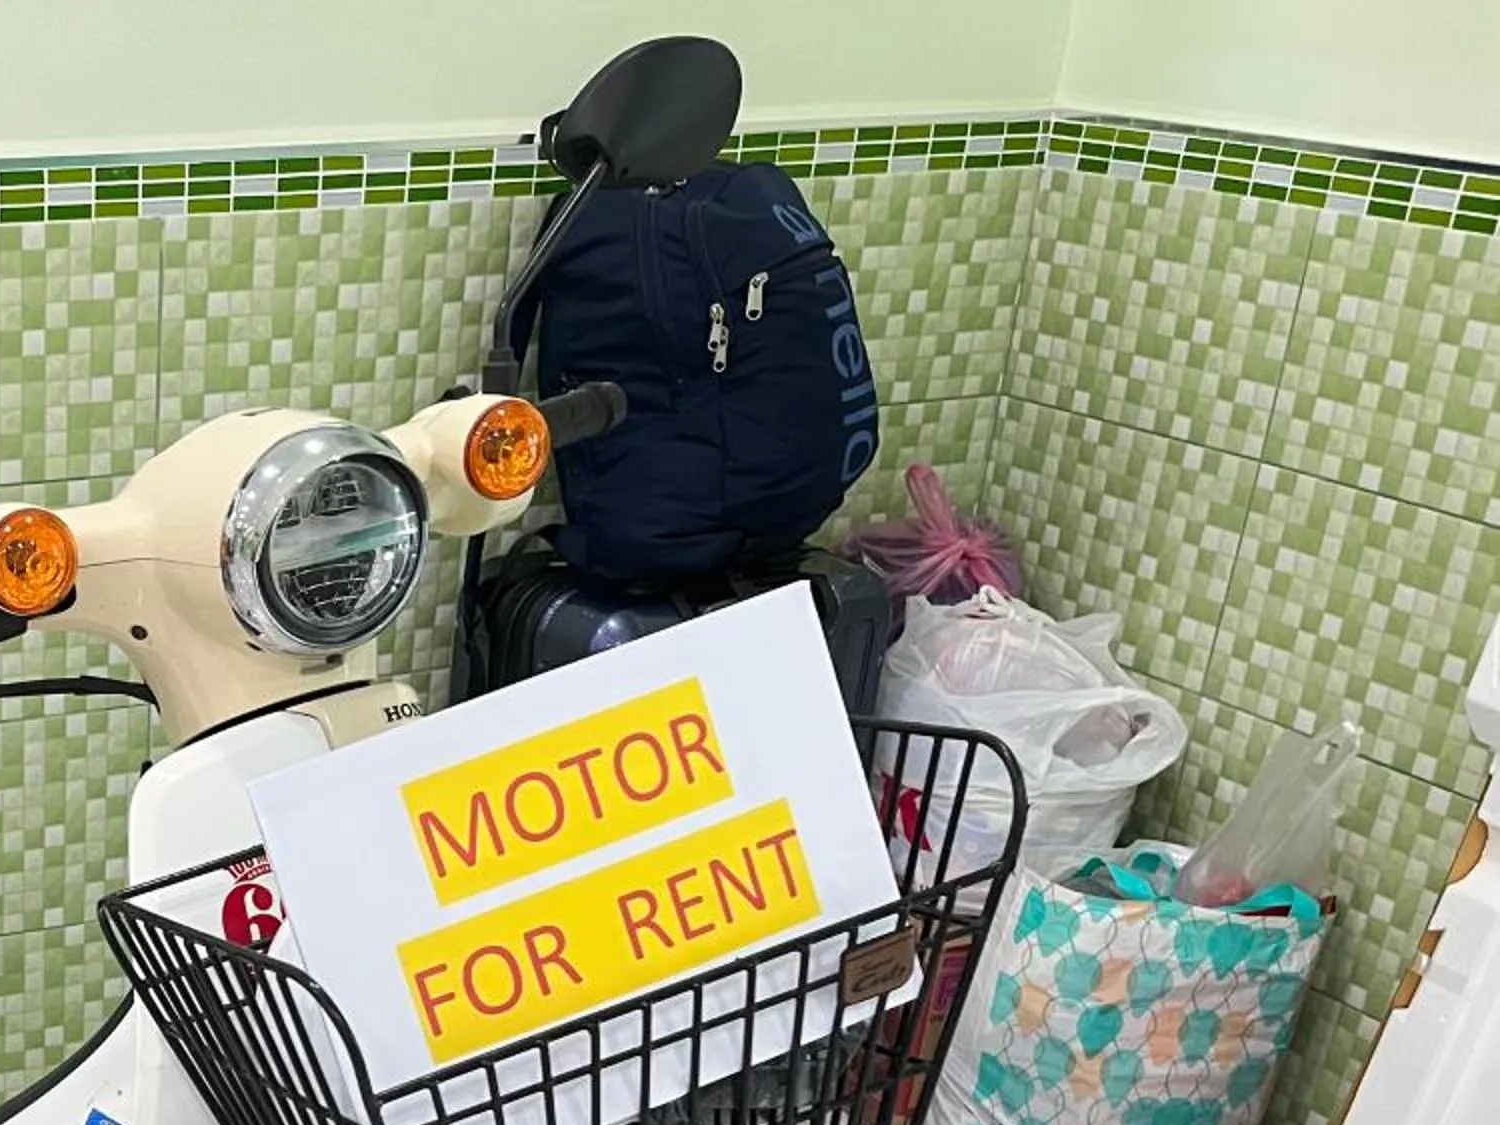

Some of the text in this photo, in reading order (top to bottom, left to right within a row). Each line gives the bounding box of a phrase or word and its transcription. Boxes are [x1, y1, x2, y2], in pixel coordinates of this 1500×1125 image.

[418, 713, 724, 878] MOTOR
[414, 829, 797, 1037] FOR RENT
